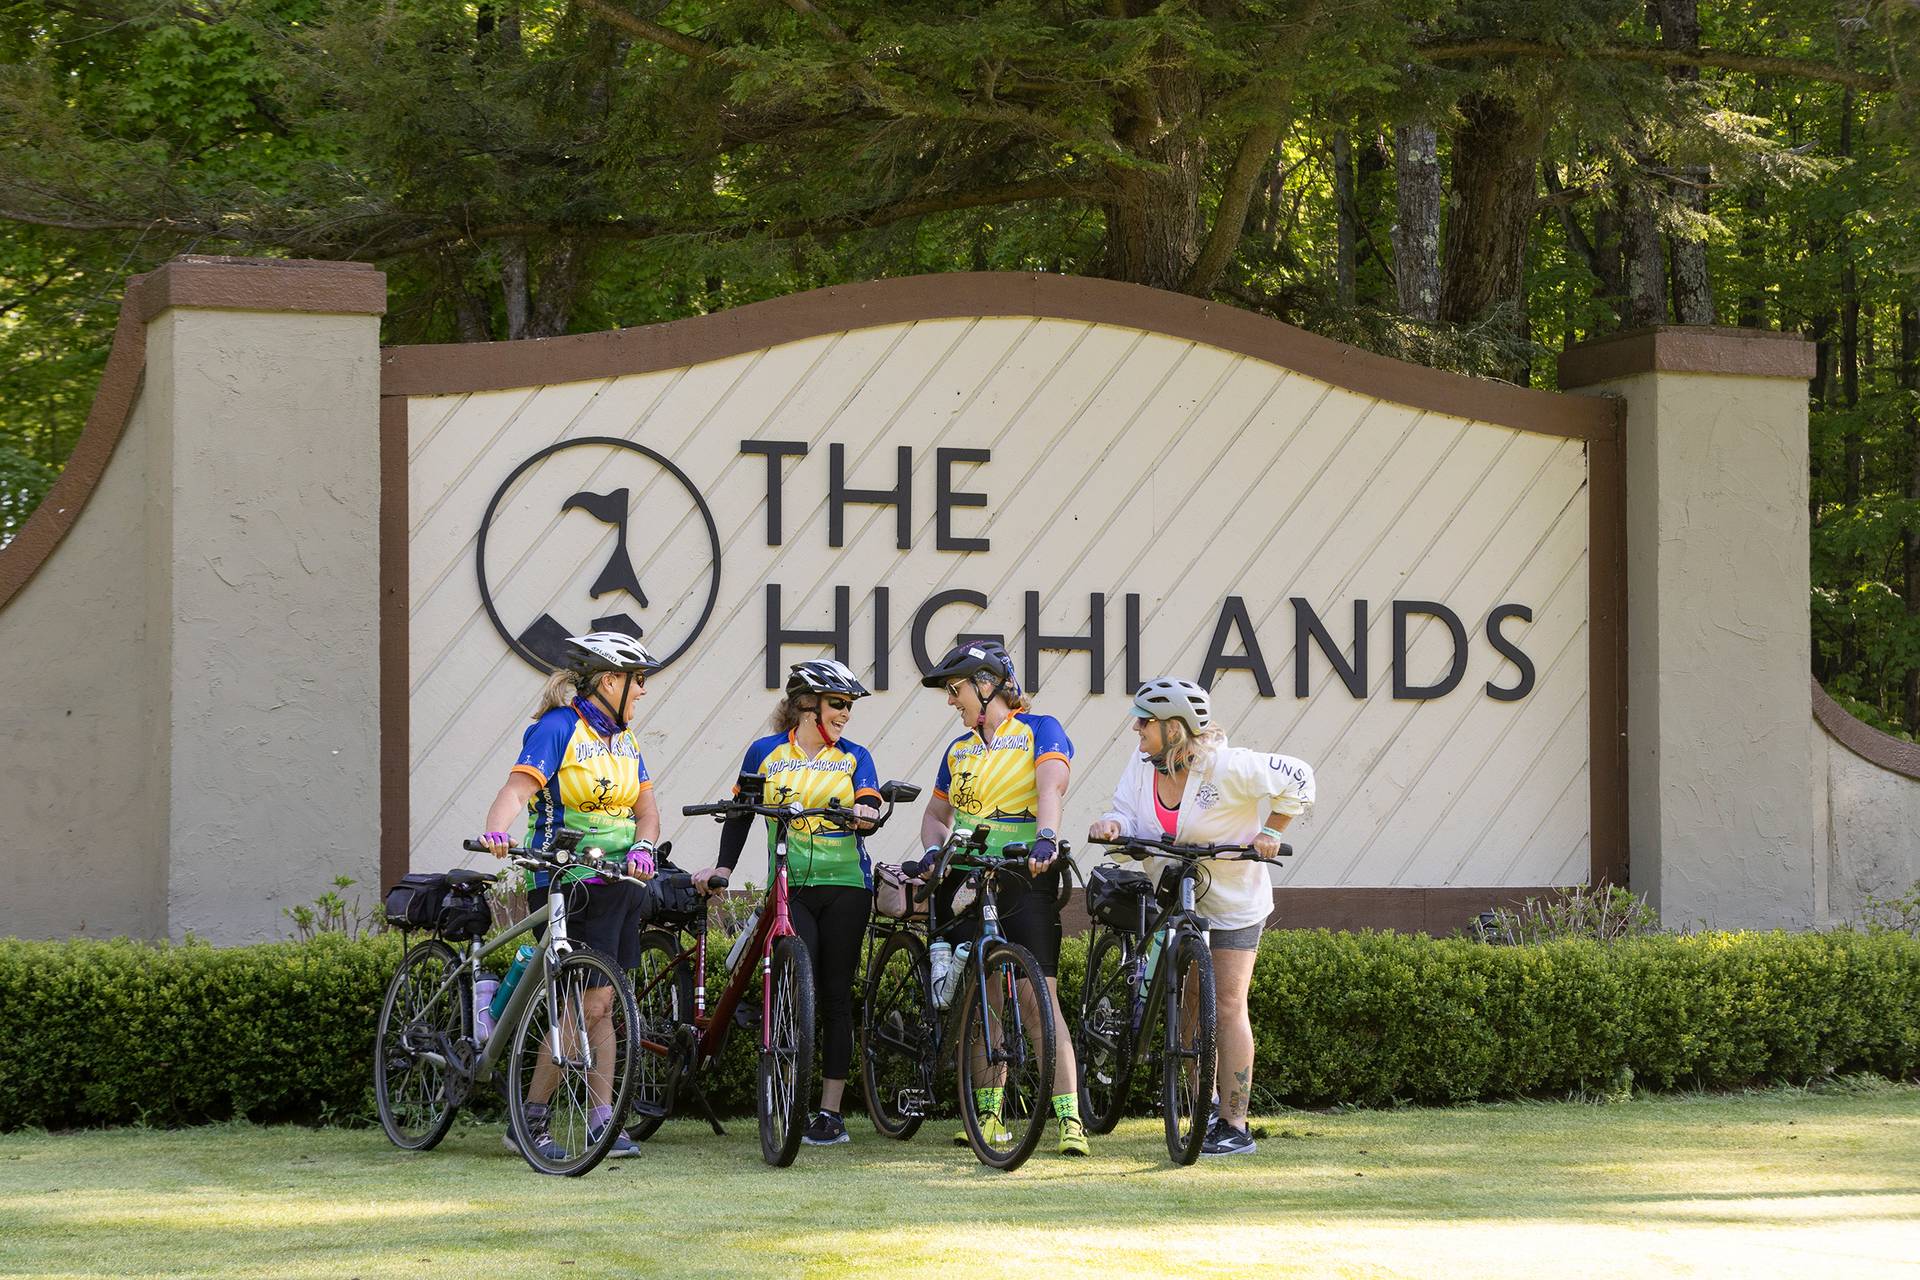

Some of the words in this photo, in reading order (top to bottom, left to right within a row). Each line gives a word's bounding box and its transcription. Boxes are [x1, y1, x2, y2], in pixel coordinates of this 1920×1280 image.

[740, 439, 991, 552] THE
[765, 583, 1537, 701] HIGHLANDS
[541, 787, 555, 852] OO-DE-MACK.COM
